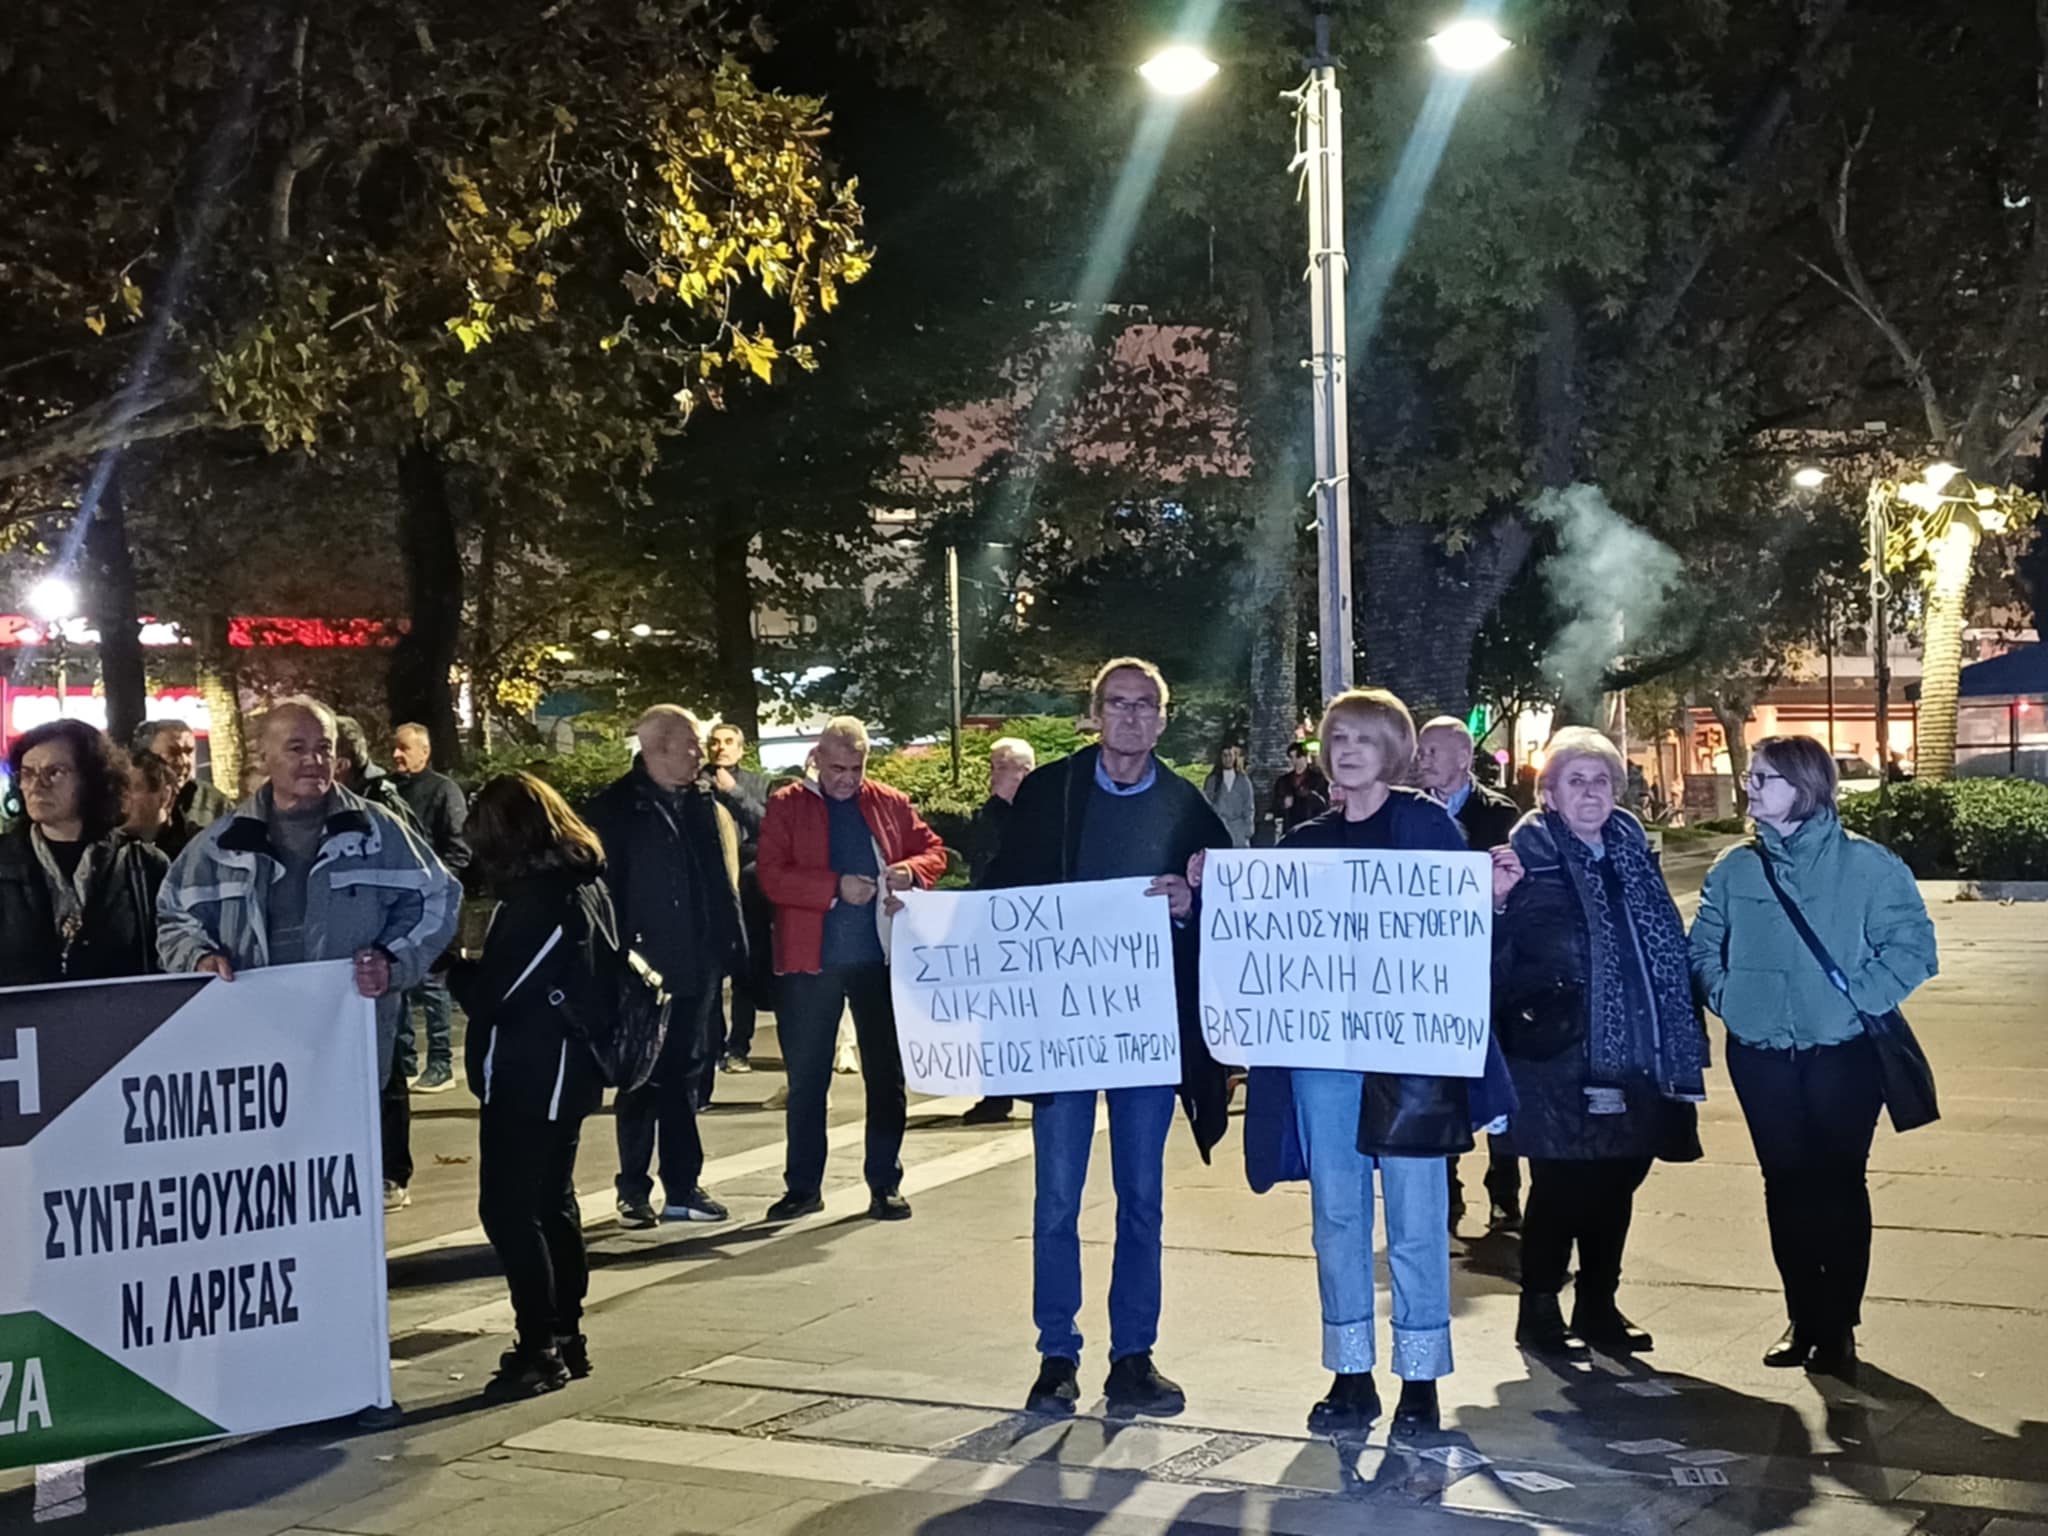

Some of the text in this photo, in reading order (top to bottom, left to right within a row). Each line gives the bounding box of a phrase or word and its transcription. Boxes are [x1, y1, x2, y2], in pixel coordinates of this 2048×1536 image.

[1216, 859, 1480, 902] ΨΩΜΙ ΠΑΙΔΕΙΑ
[988, 895, 1064, 932] ΟΧΙ
[1211, 907, 1369, 942] ΔΙΚΑΙΟΣΥΝΗ
[913, 932, 1160, 983] ΣΤΗ ΣΥΓΚΑΛΥΨΗ
[1239, 950, 1449, 995] ΔΙΚΑΙΗ ΔΙΚΗ
[930, 982, 1141, 1023] ΔΙΚΑΙΗ ΔΙΚΗ
[1203, 1004, 1332, 1047] ΒΑΣΙΛΕΙΟΣ
[908, 1040, 1034, 1080] ΒΑΣΙΛΕΙΟΣ
[121, 1062, 288, 1144] ΣΩΜΑΤΕΙΟ
[43, 1153, 361, 1260] ΣΥΝΤΑΞΙΟΥΧΩΝ ΙΚΑ
[121, 1258, 298, 1350] Ν. ΛΑΡΙΣΑΣ
